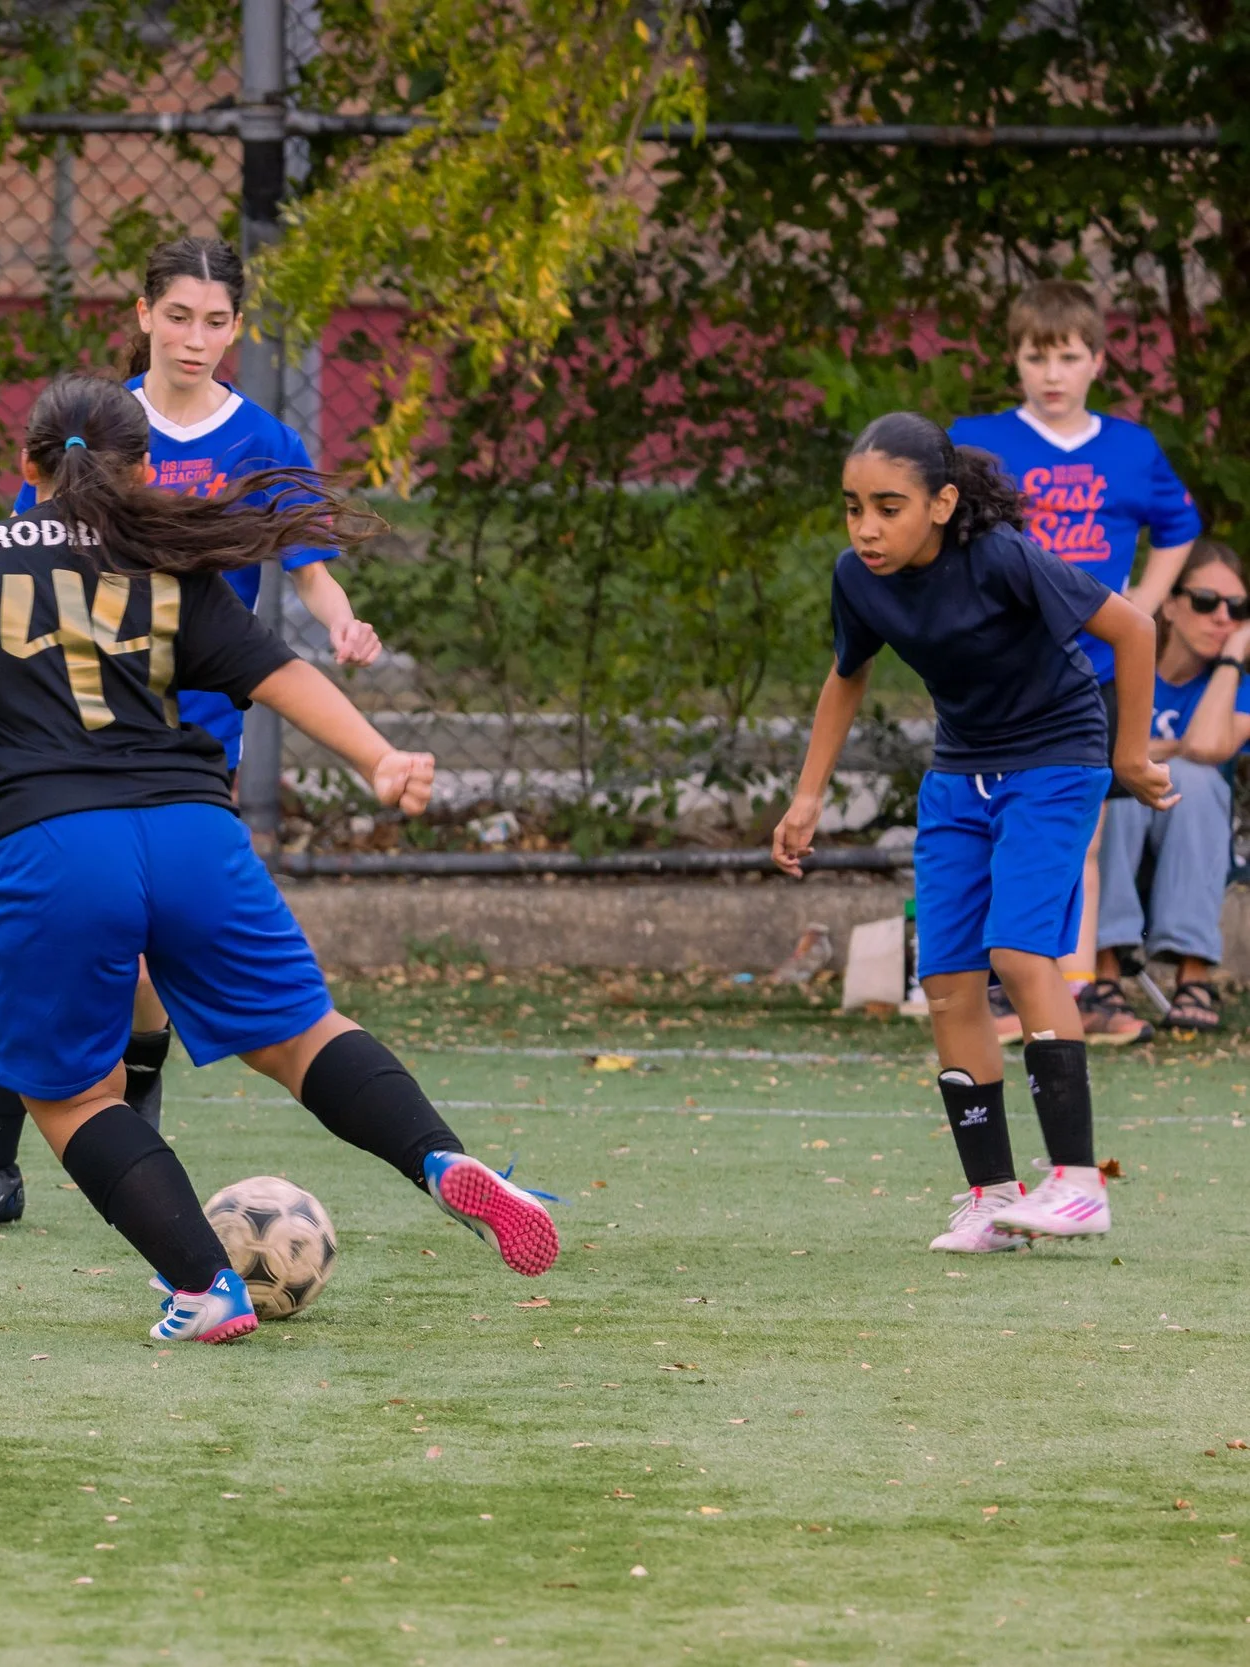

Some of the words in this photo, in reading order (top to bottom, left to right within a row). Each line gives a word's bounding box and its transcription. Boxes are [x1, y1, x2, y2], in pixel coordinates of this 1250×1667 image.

[1021, 467, 1108, 516] East
[1027, 511, 1111, 553] Side
[0, 568, 181, 732] 44
